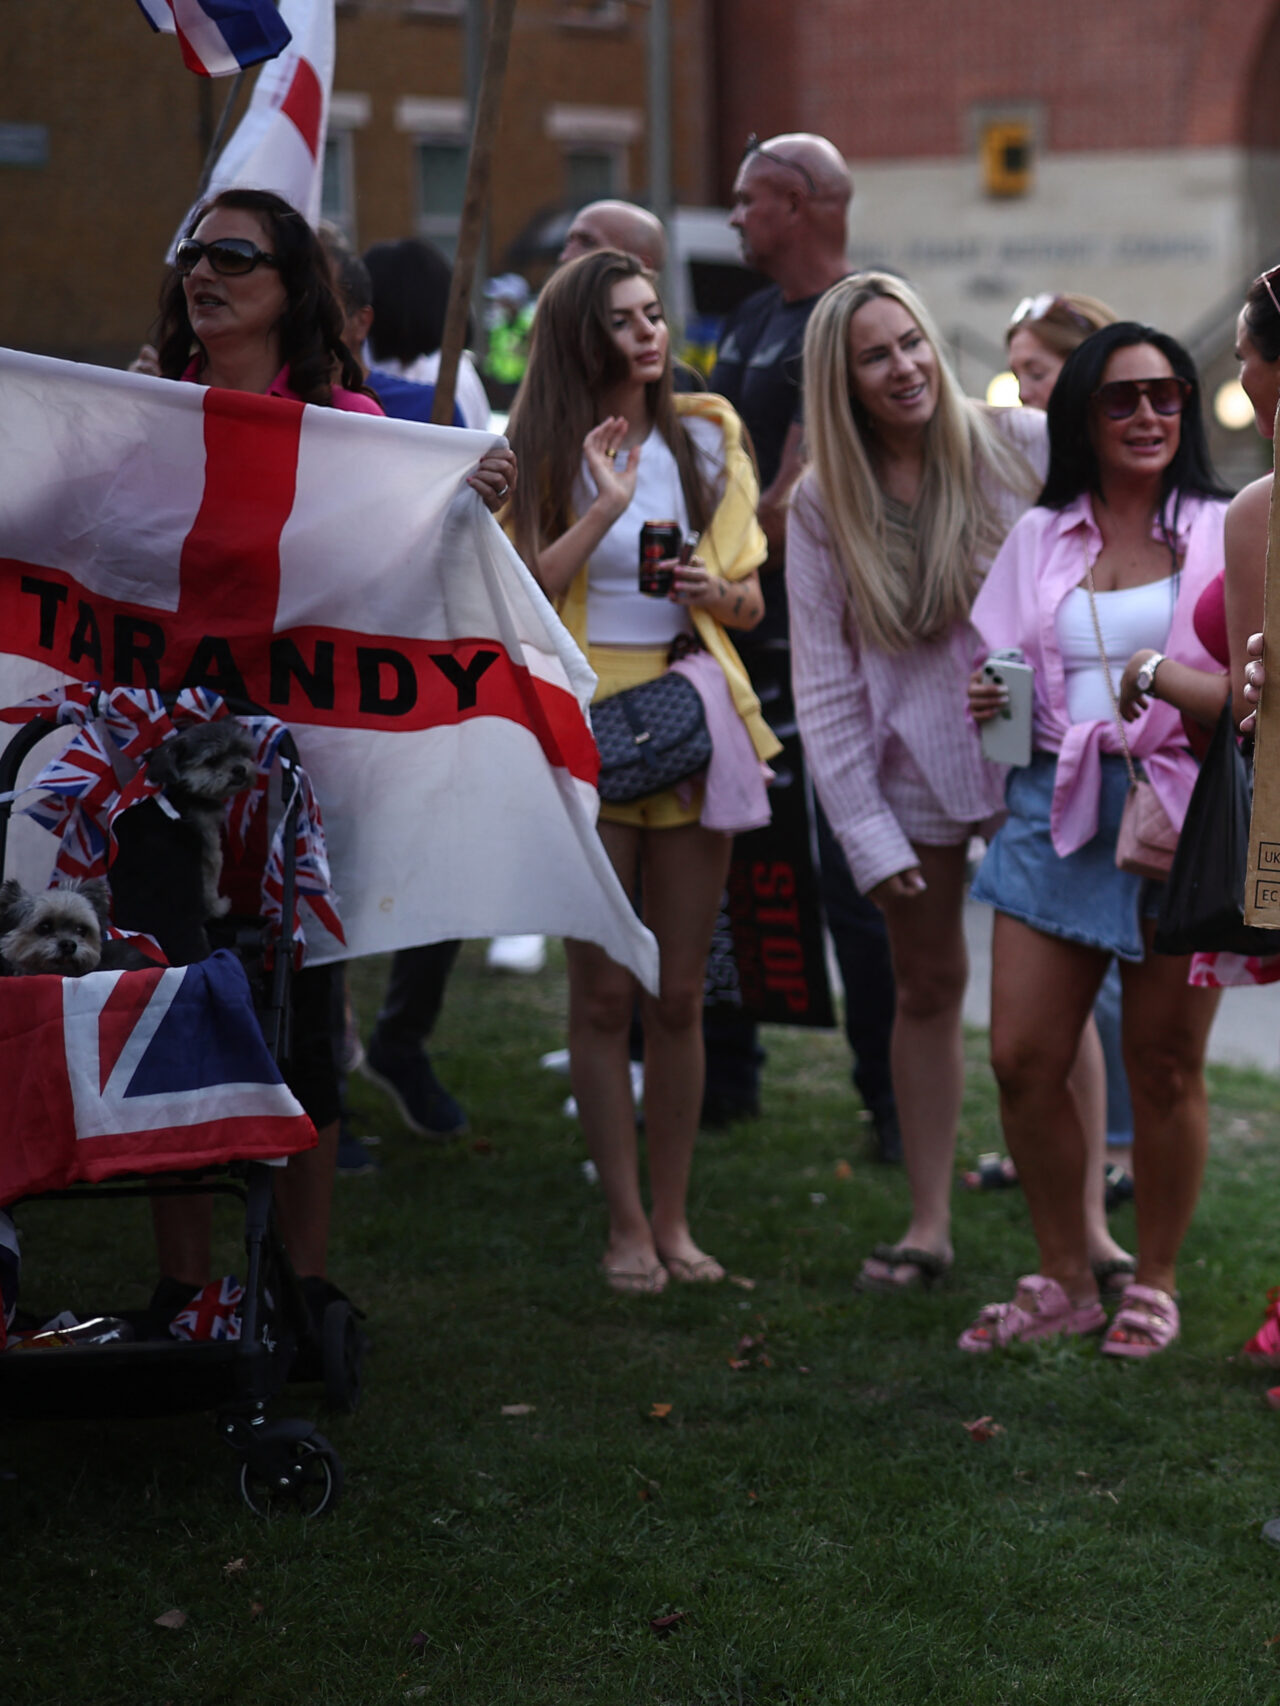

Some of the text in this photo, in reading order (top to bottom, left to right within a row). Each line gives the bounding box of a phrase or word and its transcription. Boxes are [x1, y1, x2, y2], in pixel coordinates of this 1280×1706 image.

[20, 575, 500, 716] TARANDY
[1262, 889, 1278, 903] EC
[1264, 851, 1280, 864] UK
[752, 860, 809, 1012] STOP
